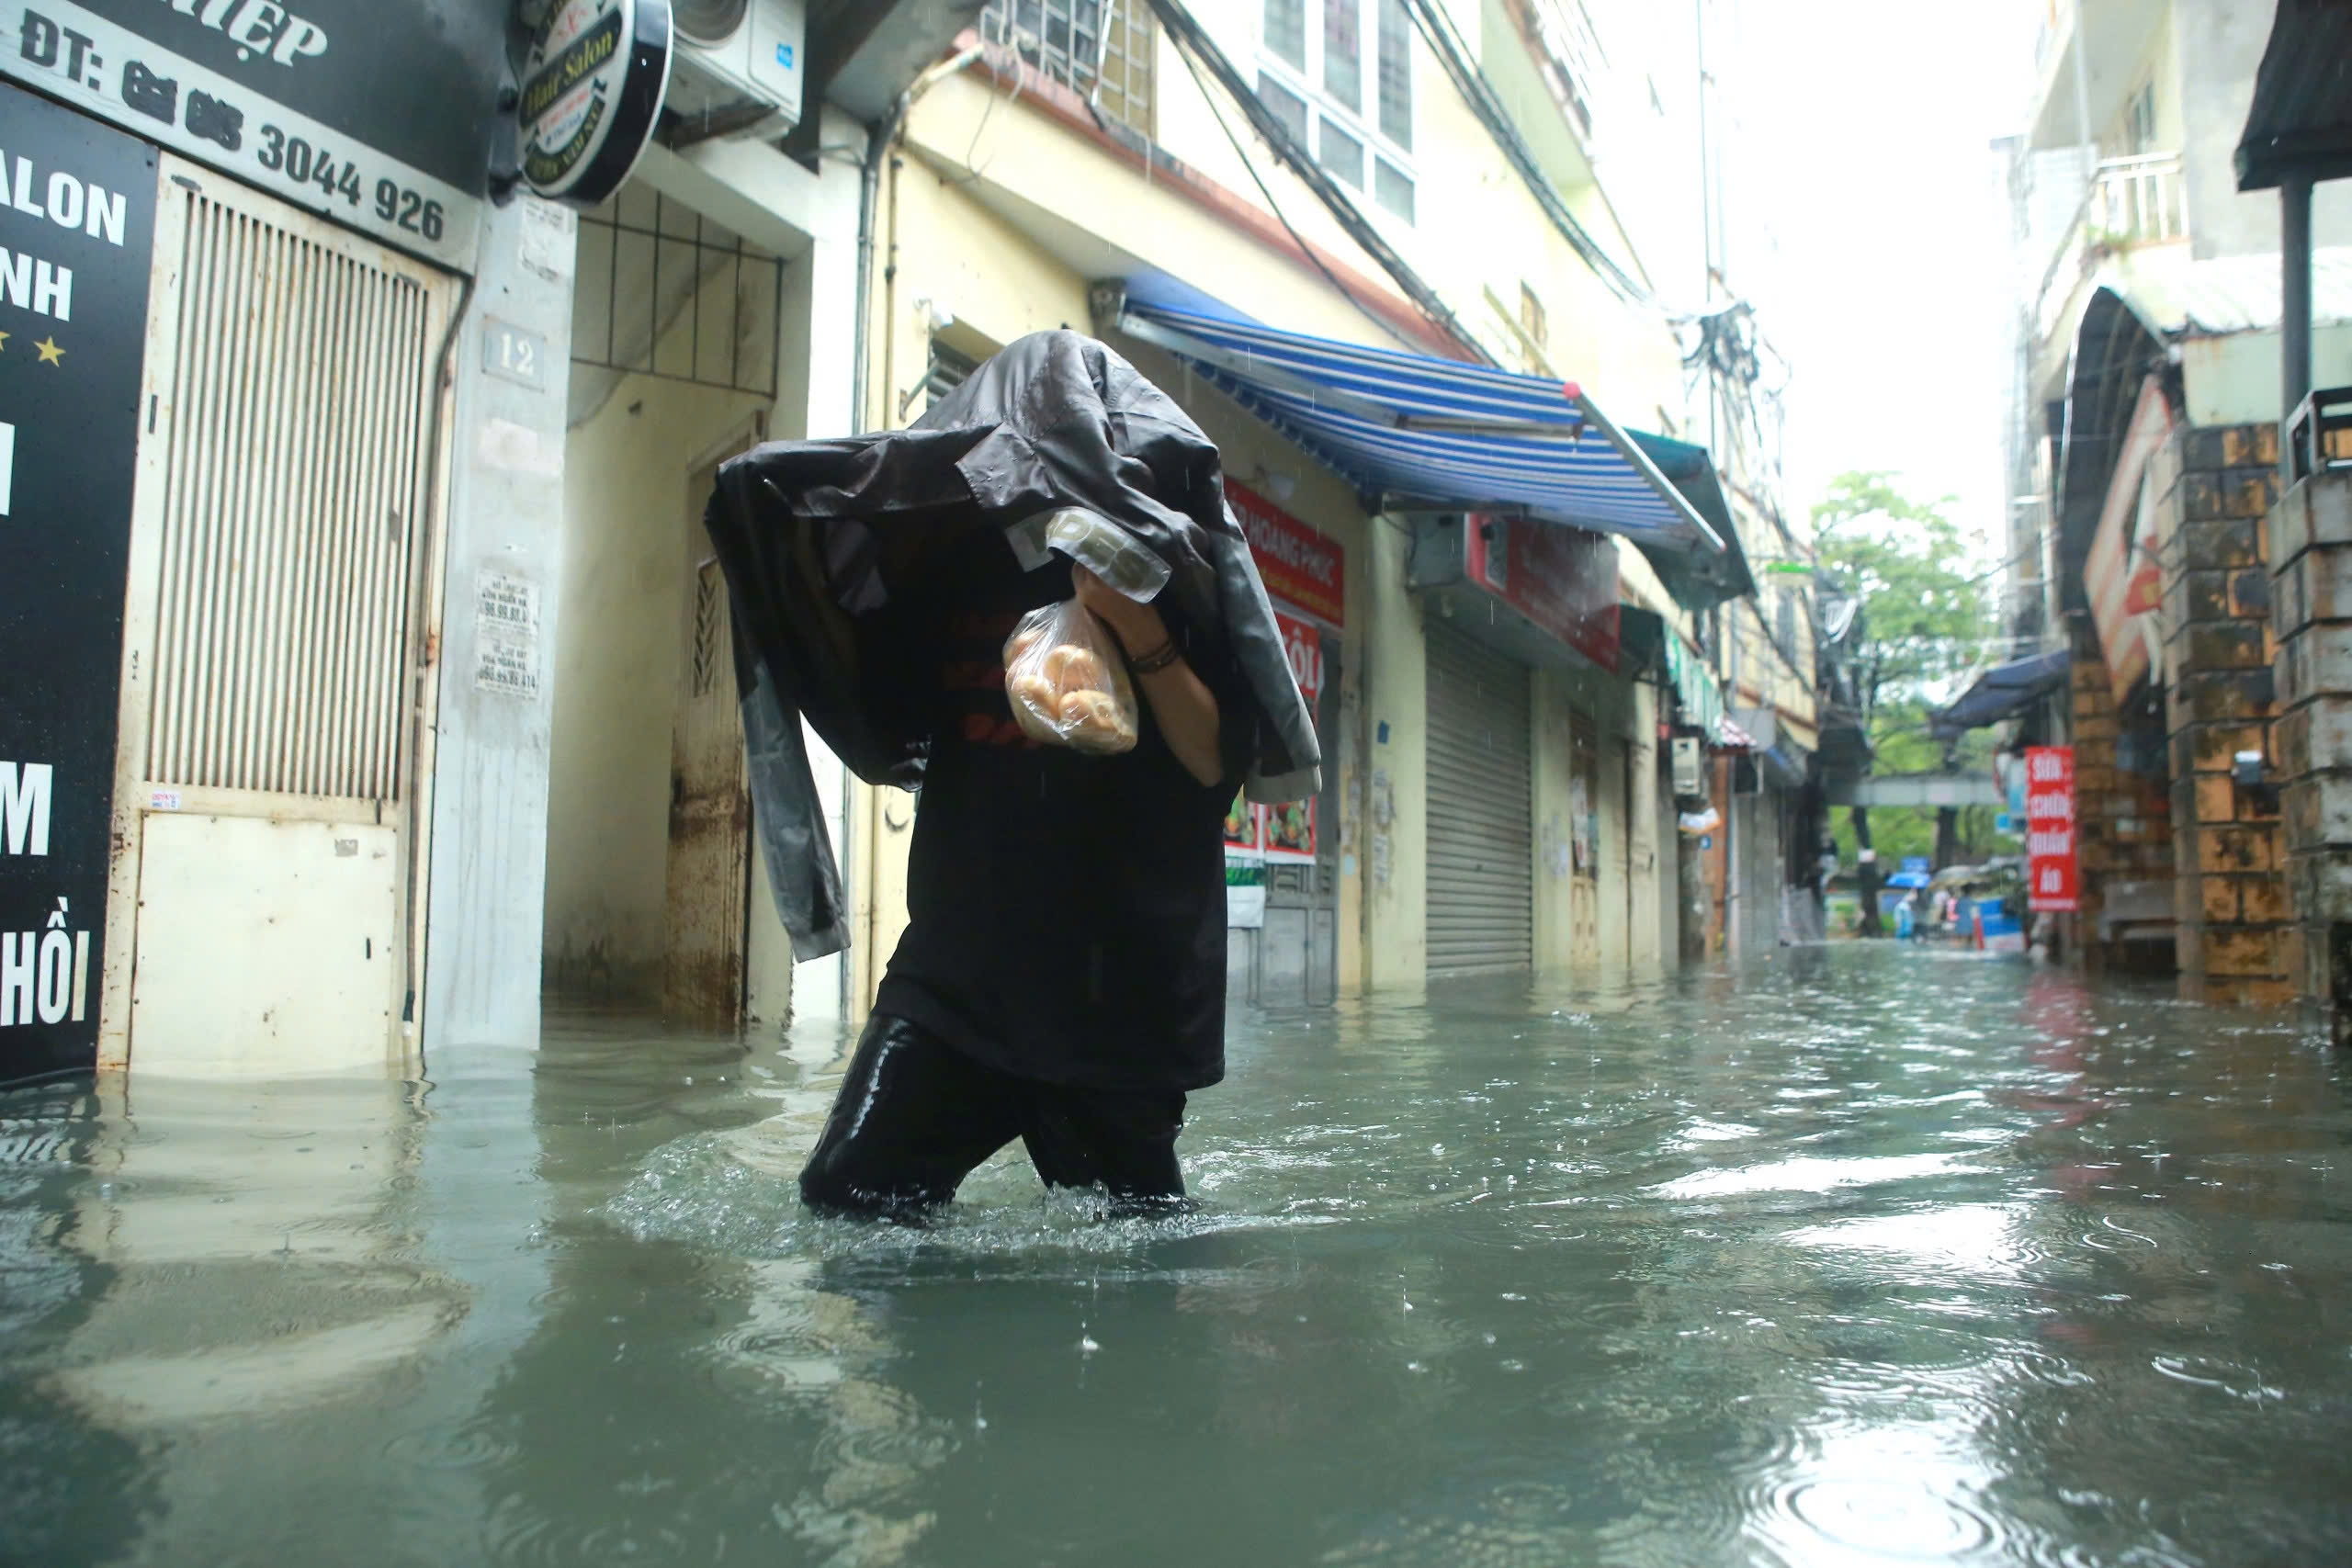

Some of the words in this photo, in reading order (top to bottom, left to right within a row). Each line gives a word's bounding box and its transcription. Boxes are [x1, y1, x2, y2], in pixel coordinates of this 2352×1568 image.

[562, 30, 614, 87] Salon
[20, 8, 103, 92] ĐT:
[257, 123, 361, 206] 3044
[375, 178, 444, 242] 926
[502, 333, 535, 377] 12
[1284, 626, 1315, 690] ÔI
[0, 761, 52, 856] M
